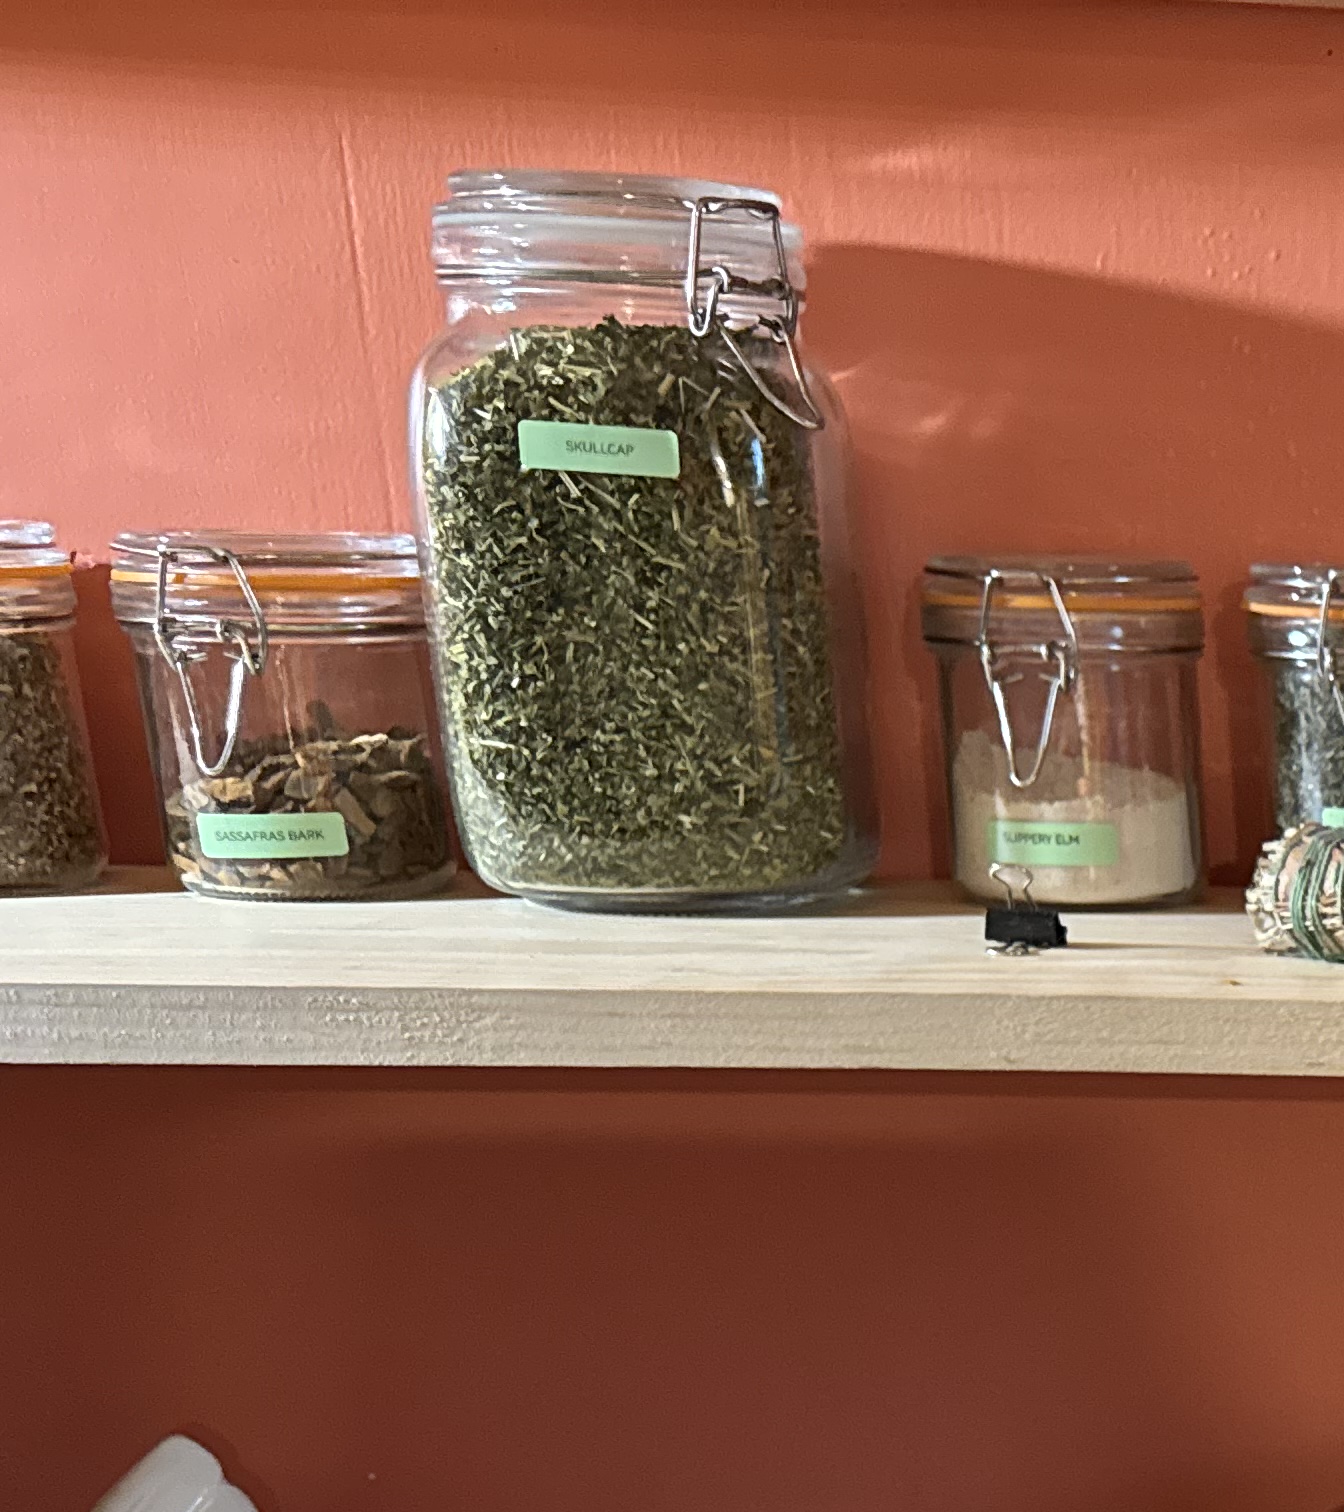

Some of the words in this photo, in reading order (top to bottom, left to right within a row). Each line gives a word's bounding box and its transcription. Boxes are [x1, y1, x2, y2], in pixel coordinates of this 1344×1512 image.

[565, 439, 634, 457] SKULLCAP
[215, 829, 285, 842] SASSAFRAS
[287, 829, 325, 841] BARK
[1003, 831, 1051, 846] SLIPPERY
[1055, 833, 1081, 846] ELM
